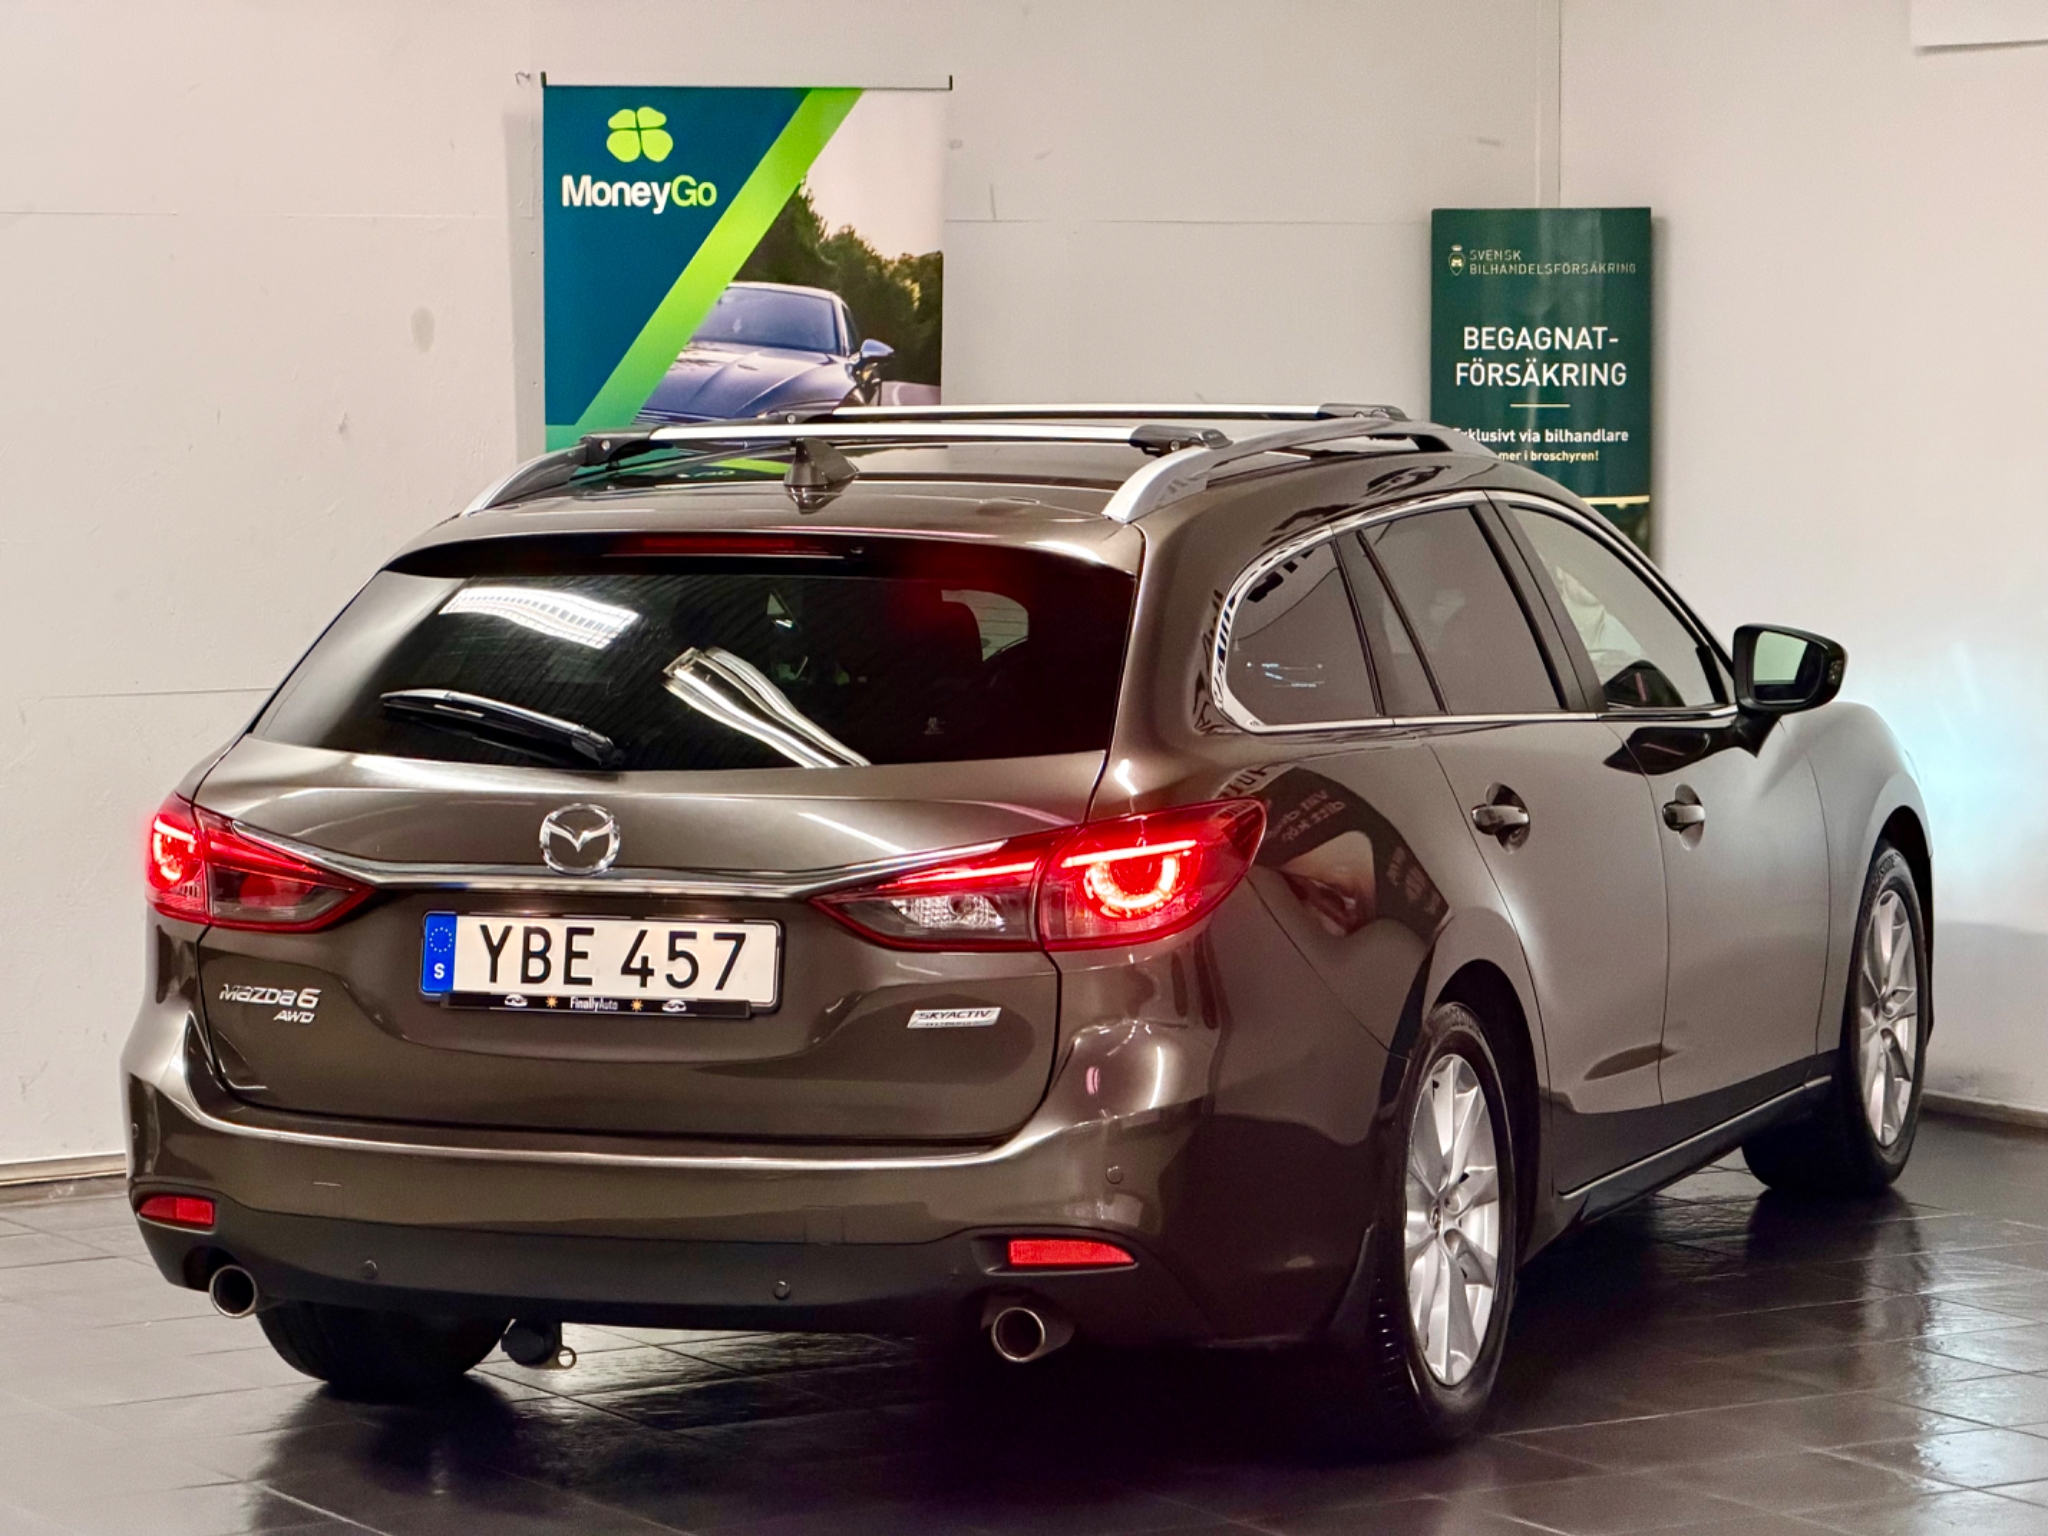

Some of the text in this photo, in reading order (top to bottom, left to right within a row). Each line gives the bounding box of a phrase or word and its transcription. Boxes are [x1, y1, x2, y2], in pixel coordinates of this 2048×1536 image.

[562, 174, 717, 214] MoneyGo
[1469, 249, 1521, 261] SVENSK
[1463, 326, 1619, 351] BEGAGNAT-
[1456, 358, 1627, 386] FÖRSÄKRING
[1453, 428, 1629, 443] klusivt via bilhandlare
[1498, 451, 1520, 461] mer
[1530, 450, 1599, 463] broschyren!
[479, 924, 747, 991] YBE 457
[433, 963, 445, 979] S
[273, 1010, 315, 1024] AWD
[919, 1009, 992, 1020] SKYACTIV
